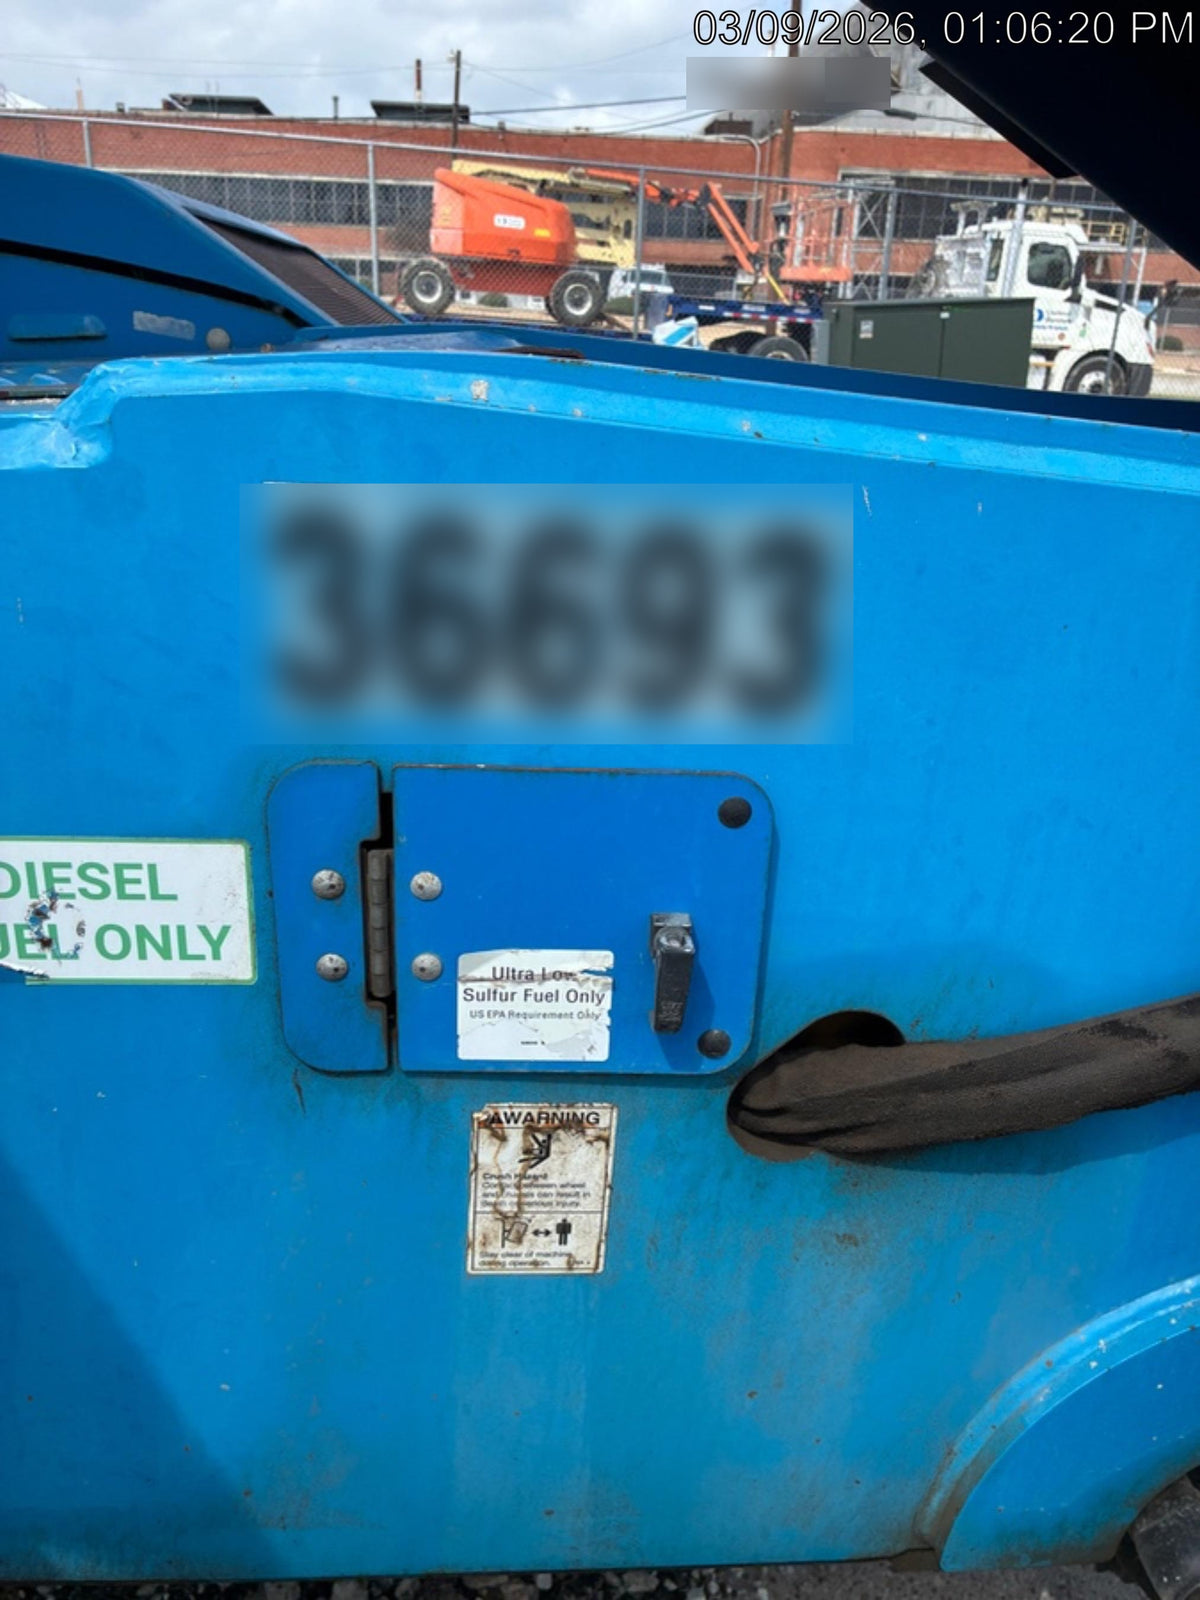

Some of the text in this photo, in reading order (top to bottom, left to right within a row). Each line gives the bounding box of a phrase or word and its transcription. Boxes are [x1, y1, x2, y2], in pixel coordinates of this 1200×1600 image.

[94, 923, 232, 961] ONLY
[492, 966, 534, 982] Ultra
[463, 988, 606, 1007] Sulfur Fuel Only
[469, 1009, 484, 1019] US
[486, 1010, 506, 1019] EPA
[508, 1010, 574, 1021] Requirement
[503, 1111, 600, 1125] WARNING
